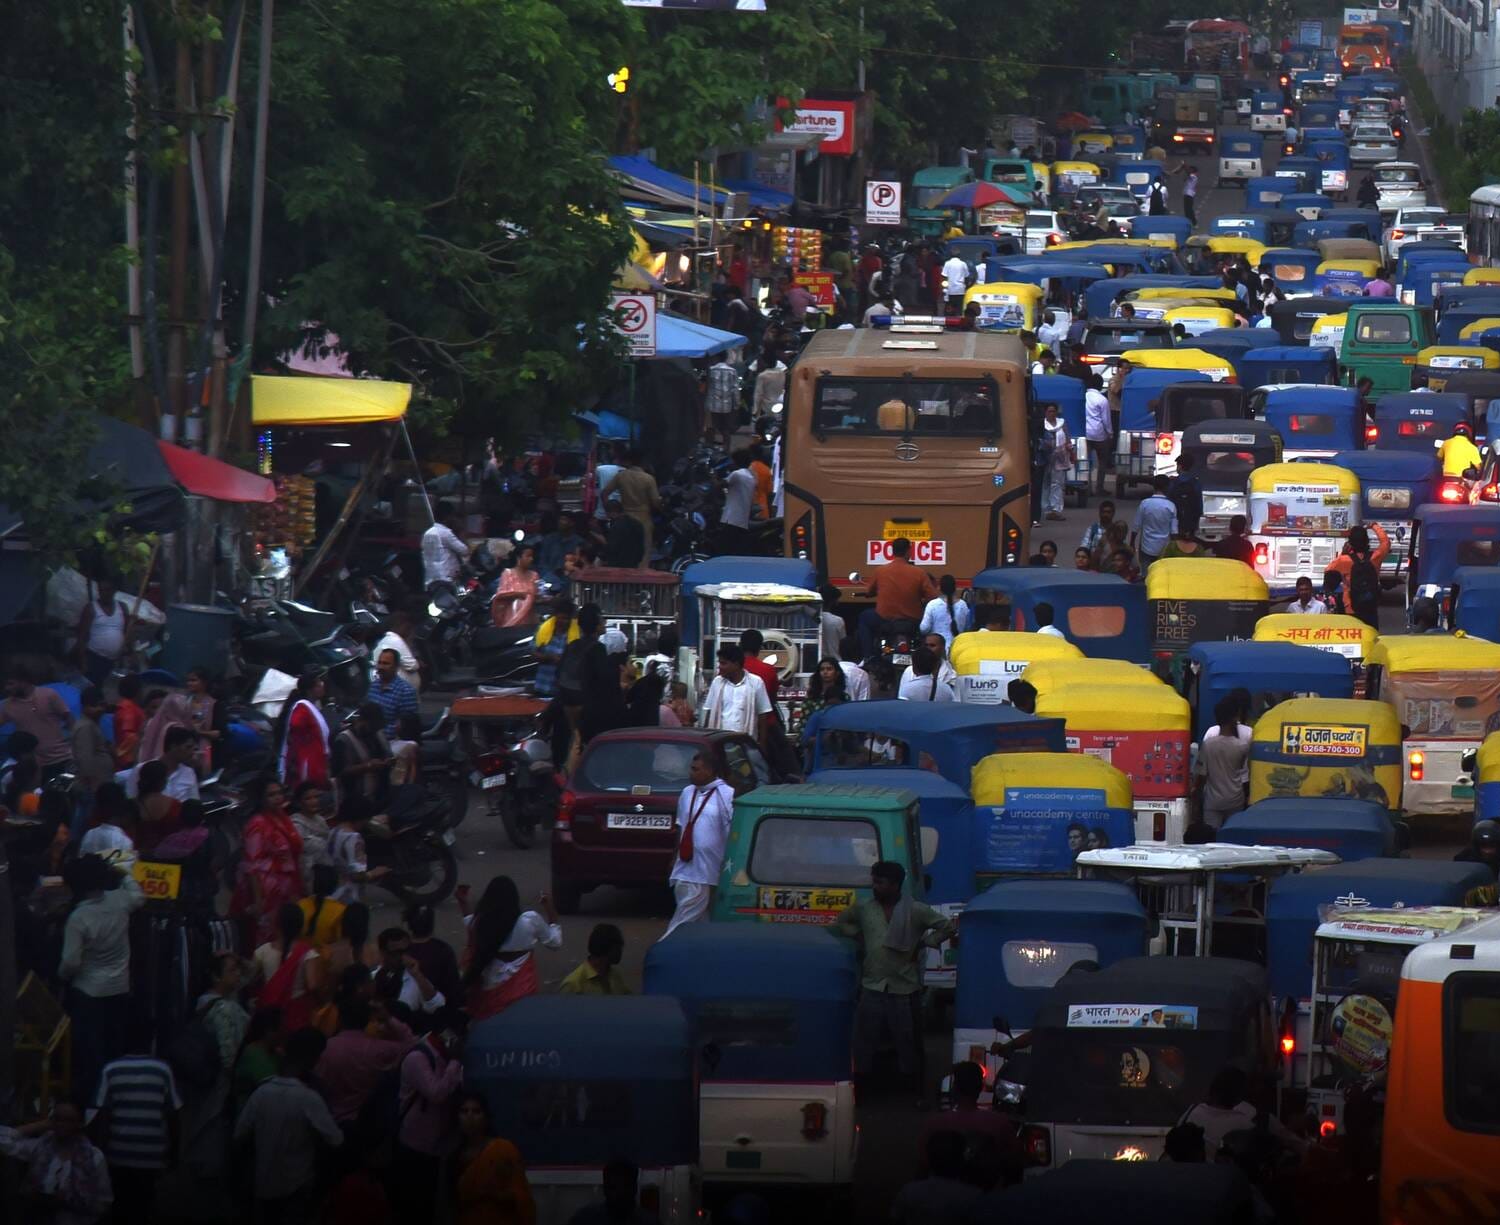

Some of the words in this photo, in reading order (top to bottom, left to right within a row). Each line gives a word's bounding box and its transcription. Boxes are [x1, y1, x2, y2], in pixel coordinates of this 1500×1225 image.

[793, 115, 837, 126] ortune
[870, 541, 944, 561] POICE
[1157, 614, 1197, 627] RIES
[1156, 627, 1190, 640] FREE
[1336, 628, 1362, 640] राम
[1304, 728, 1332, 743] वजन
[1023, 793, 1073, 802] unacademy
[1010, 810, 1073, 821] unacademy
[1076, 812, 1110, 821] centre
[1086, 1007, 1110, 1017] भारत
[1115, 1008, 1140, 1017] TAXI
